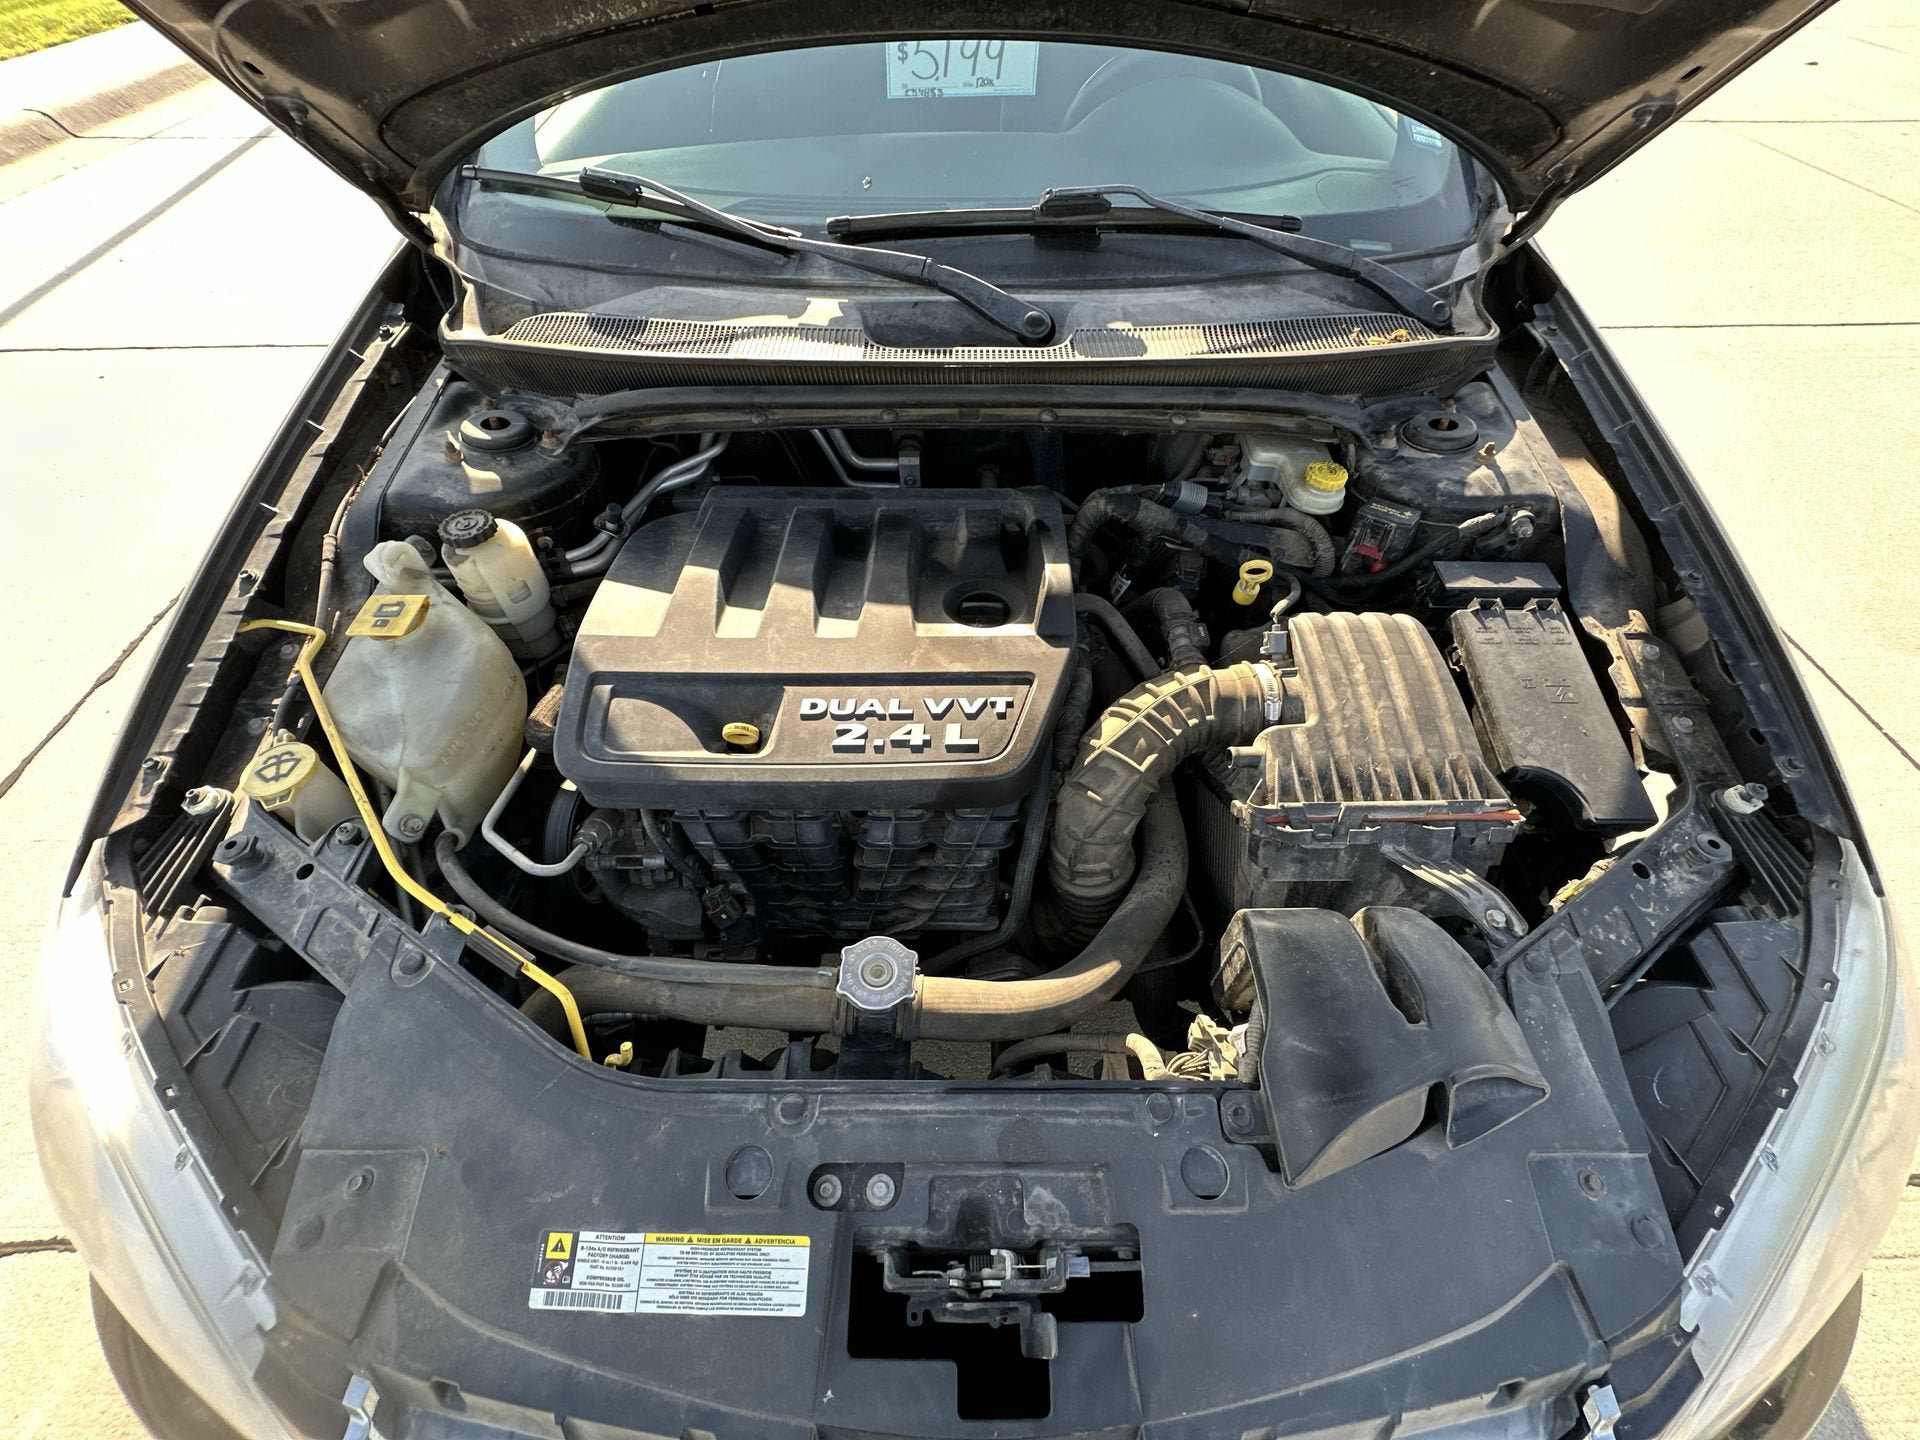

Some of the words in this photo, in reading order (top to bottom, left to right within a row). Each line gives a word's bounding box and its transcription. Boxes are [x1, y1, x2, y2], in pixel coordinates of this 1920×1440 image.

[800, 698, 914, 721] DUAL
[923, 697, 1014, 721] VVT
[832, 723, 931, 754] 2.4
[945, 723, 979, 754] L
